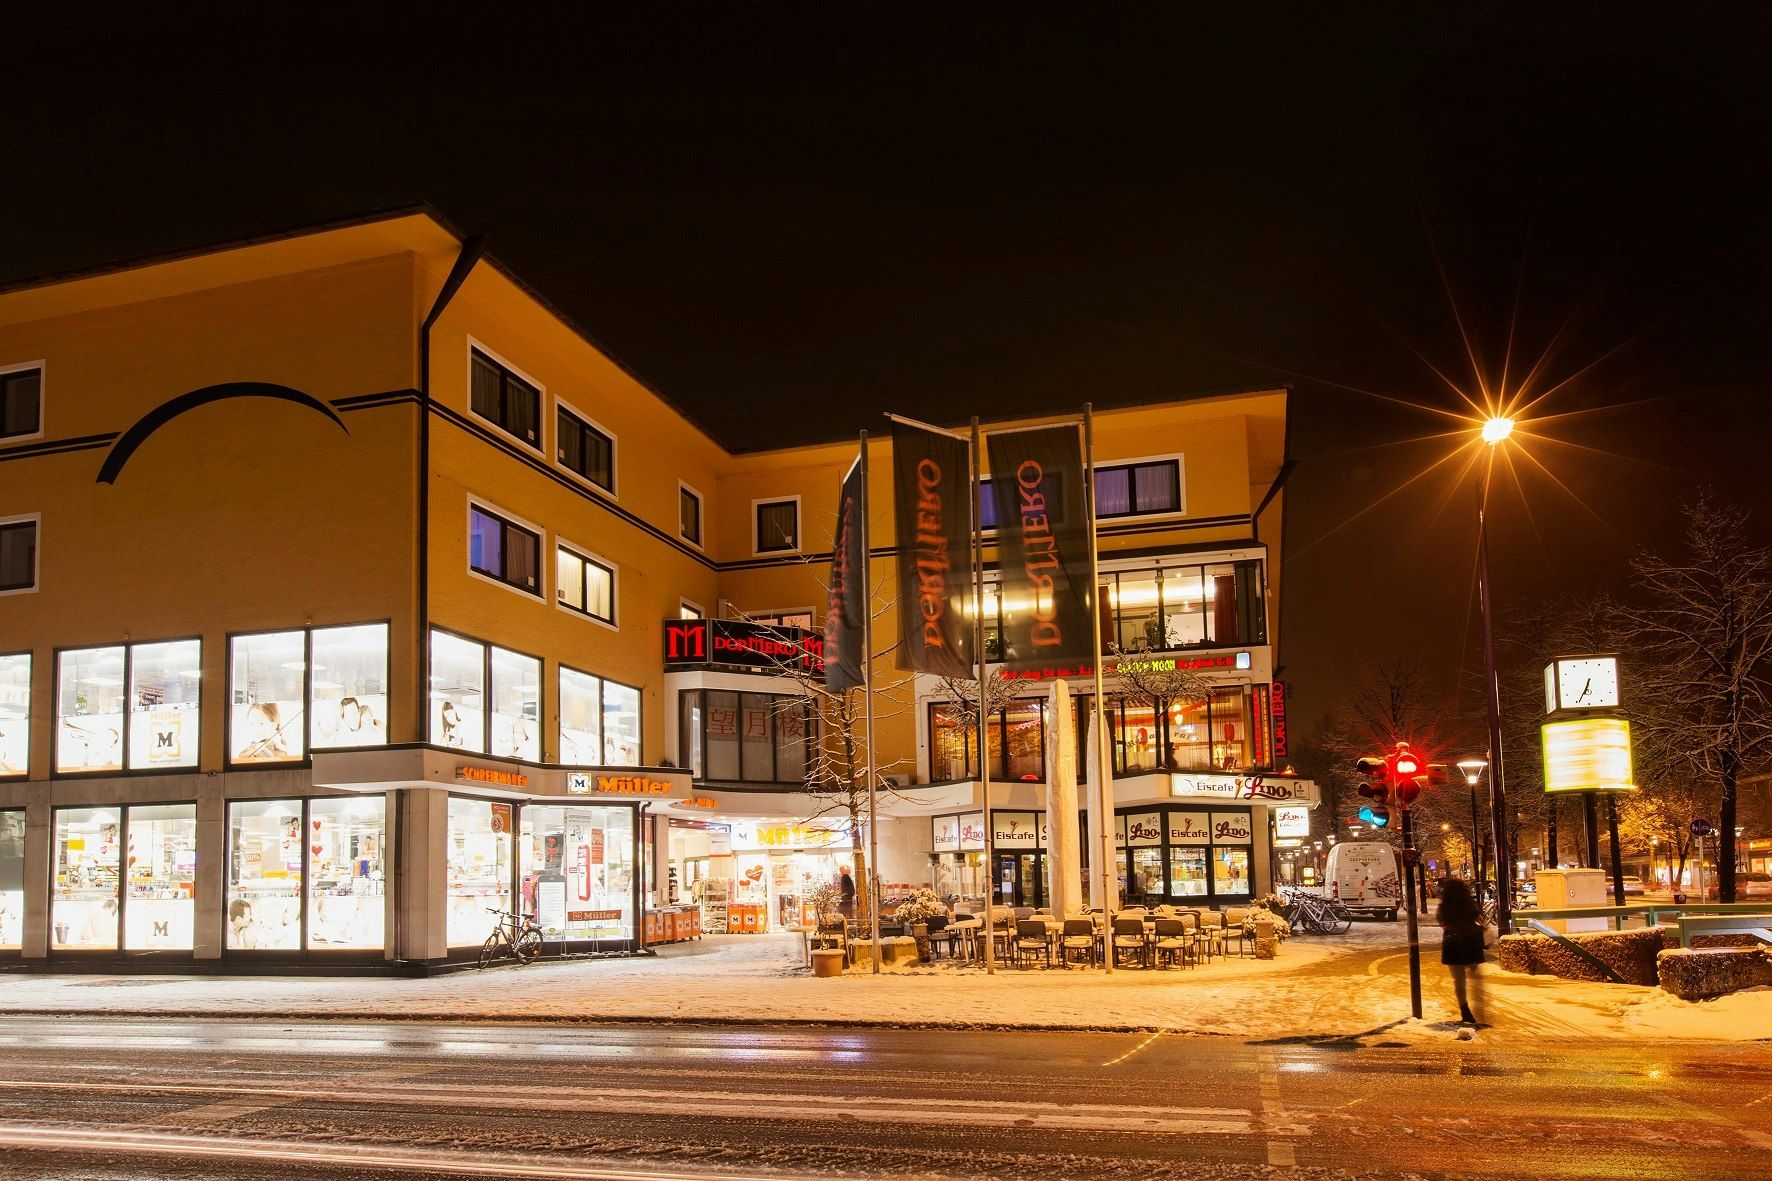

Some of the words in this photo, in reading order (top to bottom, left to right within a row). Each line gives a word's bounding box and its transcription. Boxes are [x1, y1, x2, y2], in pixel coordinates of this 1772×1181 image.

[1152, 659, 1176, 671] MOON
[709, 708, 804, 737] 望月楼
[157, 731, 173, 747] M
[462, 767, 528, 787] SCHREIBWAREN
[574, 779, 585, 788] M
[597, 776, 672, 794] Müller
[1197, 781, 1234, 792] Eiscafe
[996, 831, 1034, 840] Eiscafe
[1171, 829, 1208, 838] Eiscafe
[935, 835, 958, 844] Eiscafe
[583, 911, 616, 920] Müller
[152, 921, 169, 936] M
